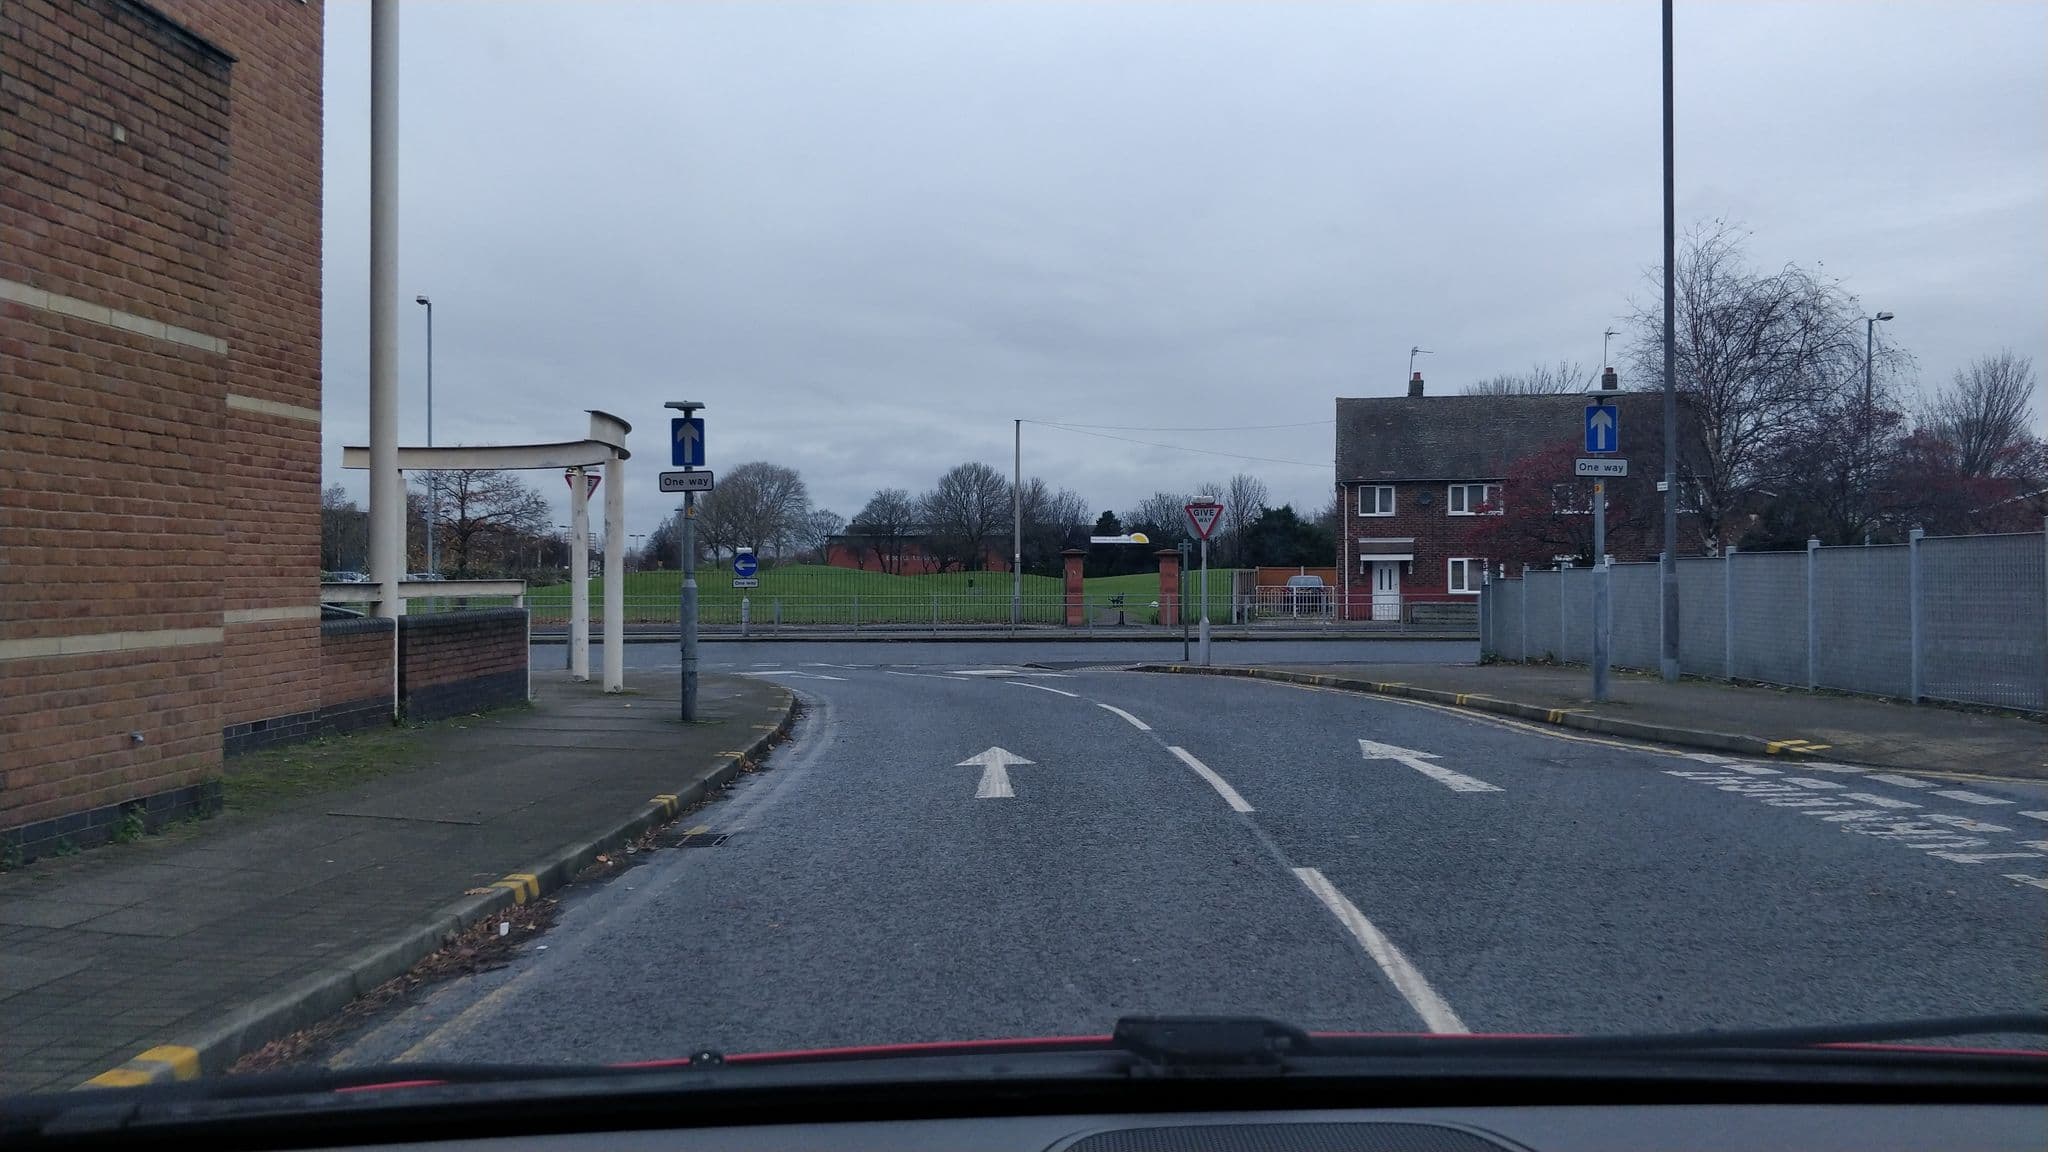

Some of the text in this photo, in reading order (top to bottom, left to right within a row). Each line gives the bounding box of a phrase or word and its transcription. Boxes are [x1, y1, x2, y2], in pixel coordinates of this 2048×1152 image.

[1579, 462, 1624, 474] One way
[664, 477, 709, 487] One way
[1193, 509, 1215, 517] GIVE
